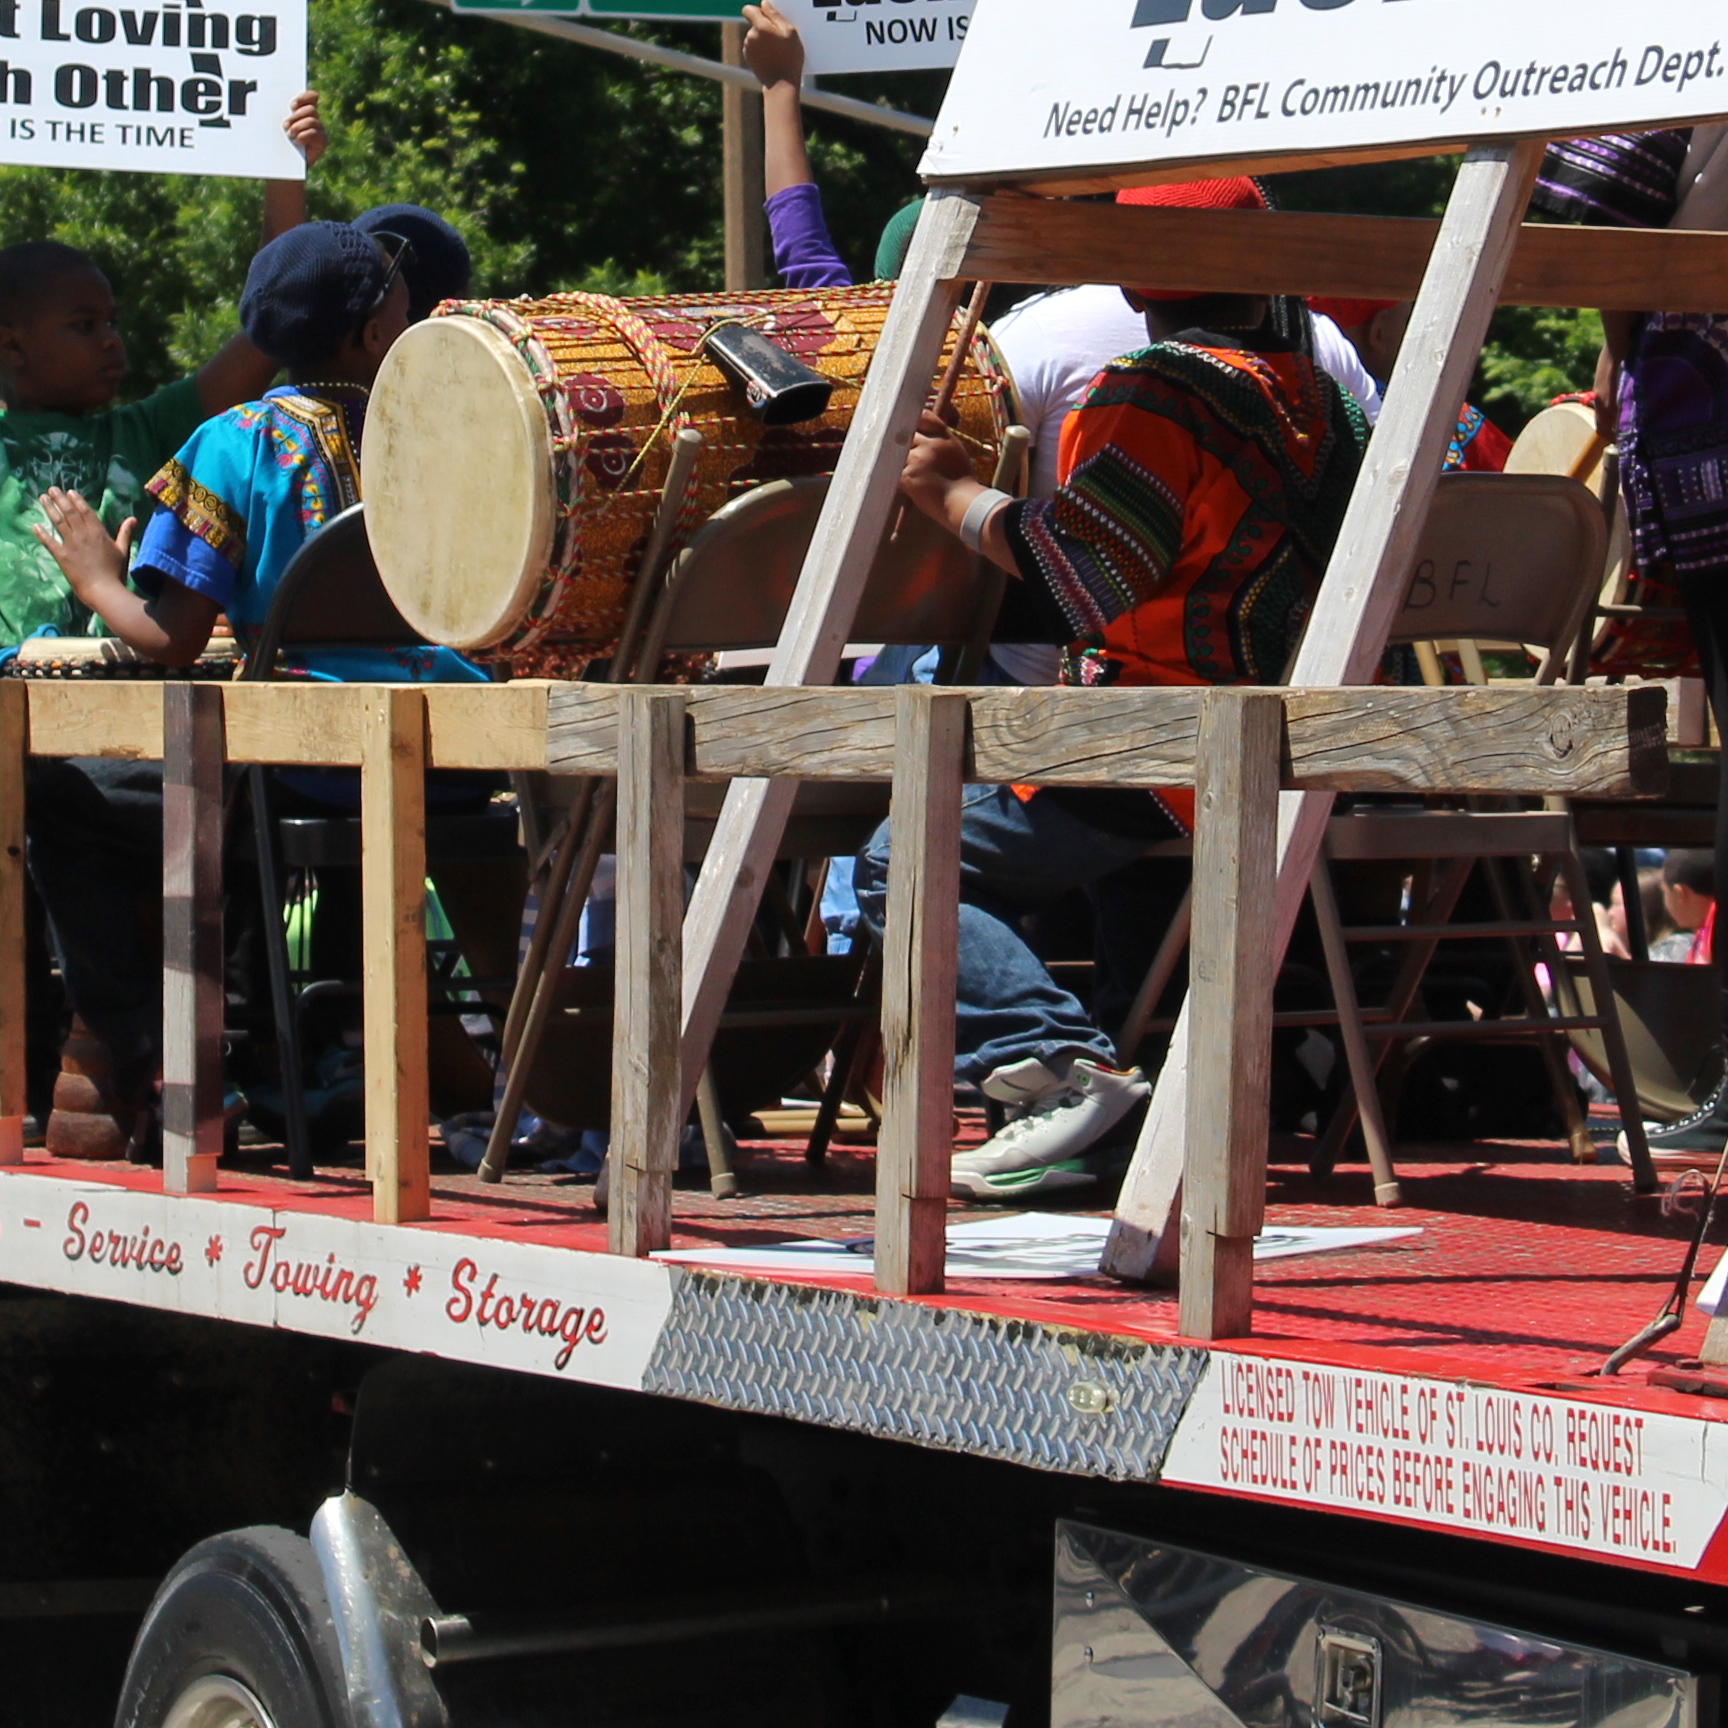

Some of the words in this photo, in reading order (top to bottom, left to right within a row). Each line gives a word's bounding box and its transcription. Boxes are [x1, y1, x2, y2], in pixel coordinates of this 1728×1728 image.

[865, 20, 943, 46] NOW
[948, 16, 969, 41] IS
[10, 118, 35, 140] IS
[45, 120, 104, 144] THE
[116, 123, 194, 149] TIME
[54, 63, 258, 116] Other
[1043, 102, 1120, 140] Need
[1121, 86, 1209, 138] Help?
[1217, 80, 1271, 125] BFL
[1281, 65, 1467, 121] Community
[1473, 56, 1626, 100] Outreach
[1634, 40, 1724, 91] Dept.
[63, 1200, 183, 1276] Service
[244, 1225, 378, 1335] Towing
[445, 1257, 608, 1370] Storage
[1221, 1358, 1295, 1424] LICENSED
[1302, 1370, 1335, 1429] TOW
[1342, 1375, 1410, 1440] VEHICLE
[1417, 1387, 1438, 1445] OF
[1446, 1389, 1470, 1449] ST.
[1474, 1393, 1522, 1459] LOUIS
[1531, 1403, 1559, 1467] CO.
[1566, 1407, 1644, 1477] REQUEST
[1220, 1426, 1297, 1490] SCHEDULE
[1302, 1435, 1322, 1494] OF
[1329, 1438, 1385, 1505] PRICES
[1393, 1448, 1454, 1514] BEFORE
[1462, 1461, 1546, 1532] ENGAGING
[1553, 1475, 1590, 1541] THIS
[1599, 1482, 1677, 1554] VEHICLE.
